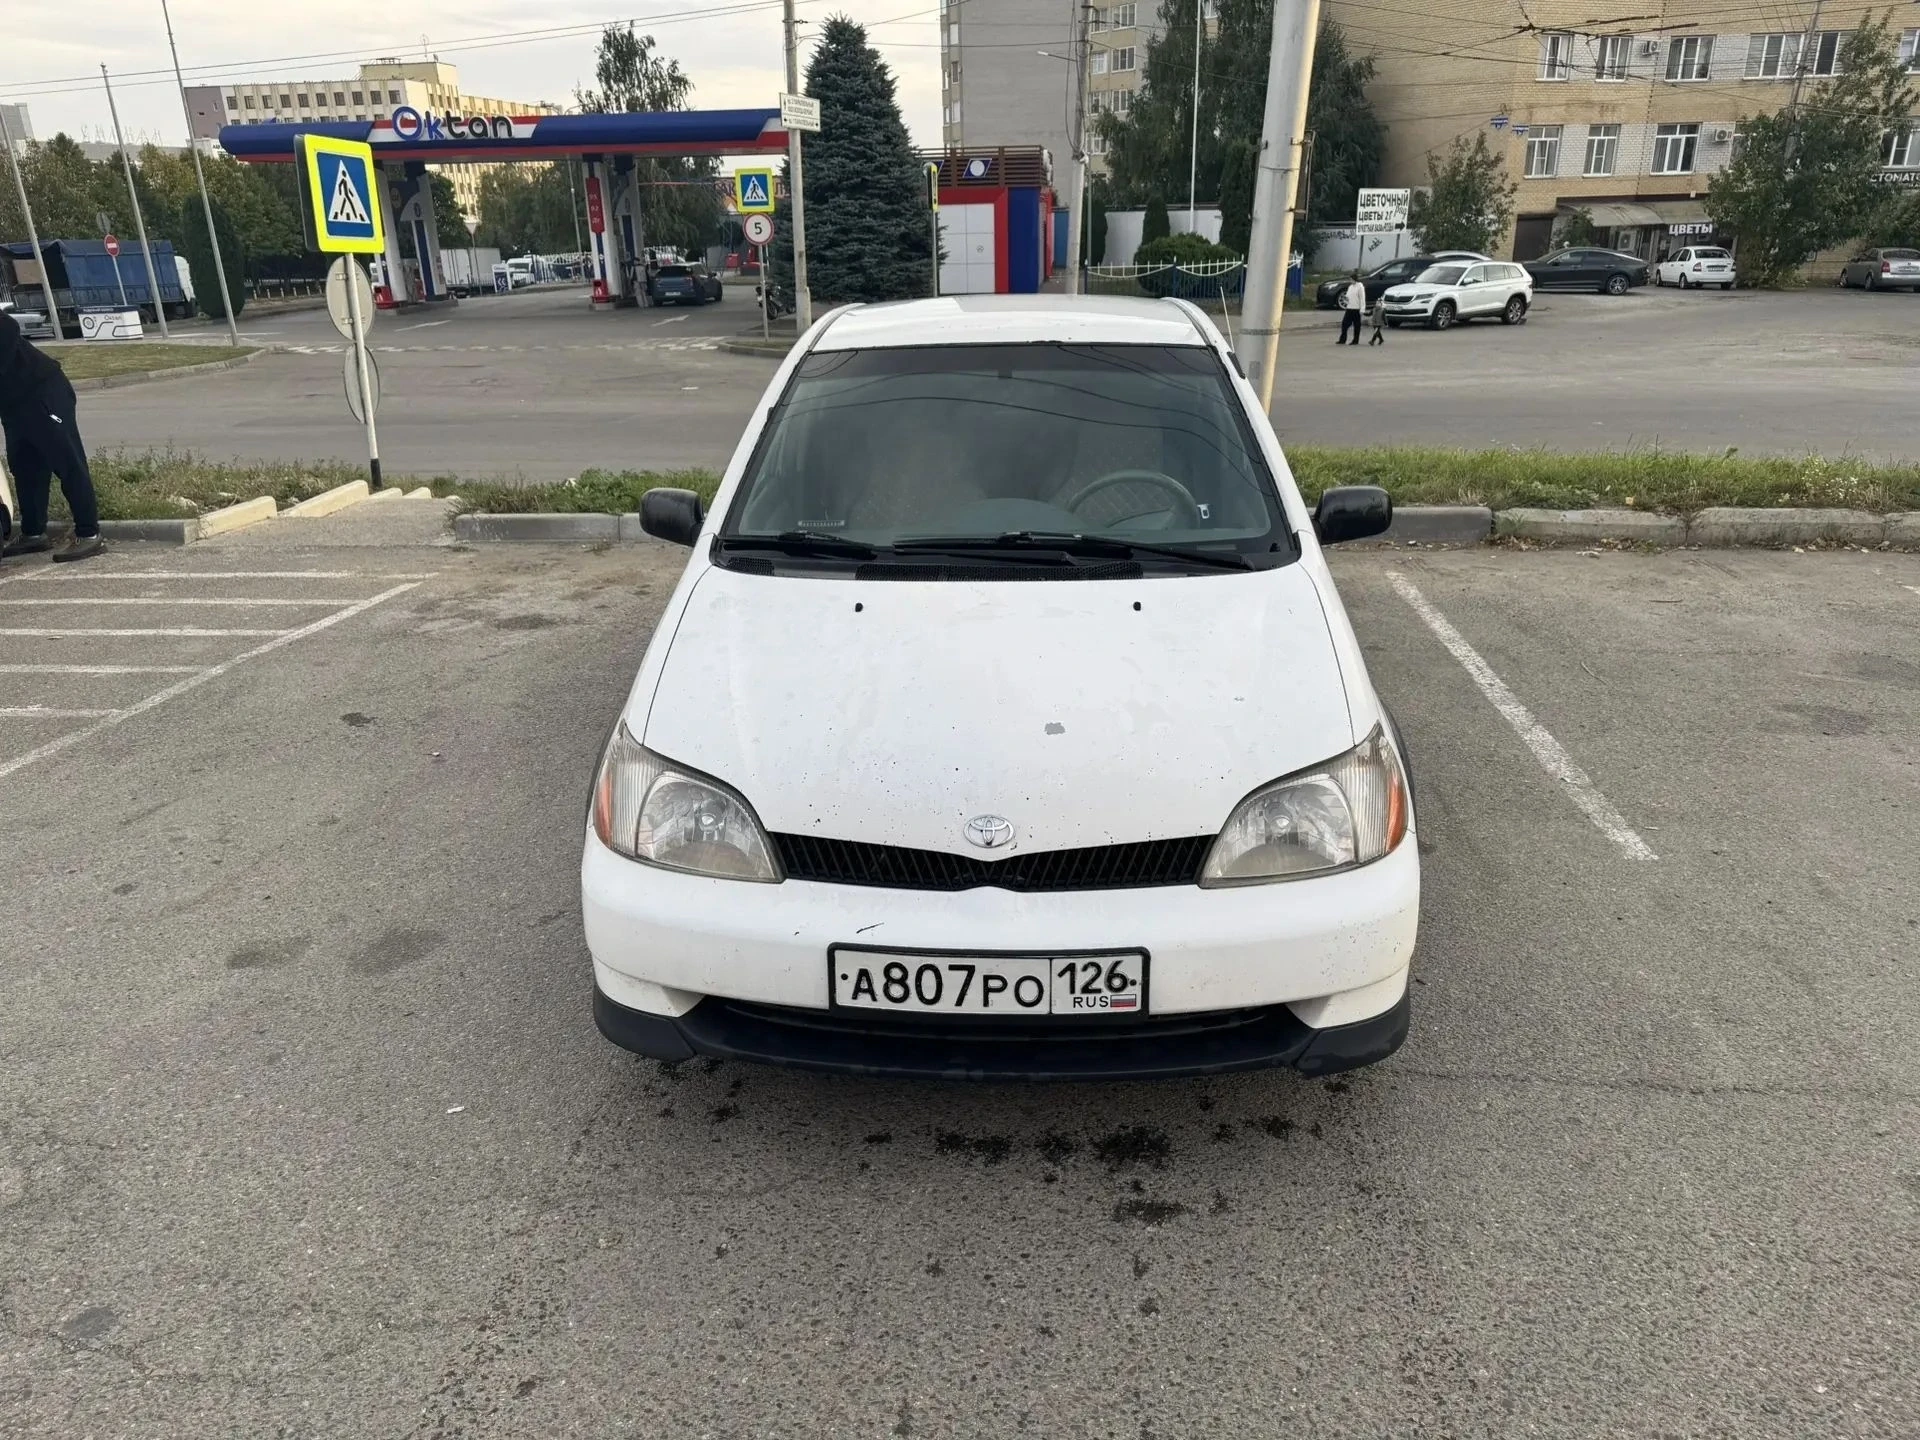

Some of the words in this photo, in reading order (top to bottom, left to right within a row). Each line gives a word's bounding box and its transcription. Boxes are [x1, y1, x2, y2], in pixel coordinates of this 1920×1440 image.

[392, 106, 513, 140] Oktan
[1359, 190, 1409, 208] ЦВЕТОЧНЫЙ
[1358, 211, 1383, 222] ЦВЕТЫ
[754, 222, 763, 235] 5
[1668, 223, 1713, 236] ЦВЕТЫ
[851, 961, 1044, 1009] А807РО
[1057, 960, 1129, 995] 126
[1072, 995, 1109, 1009] RUS
